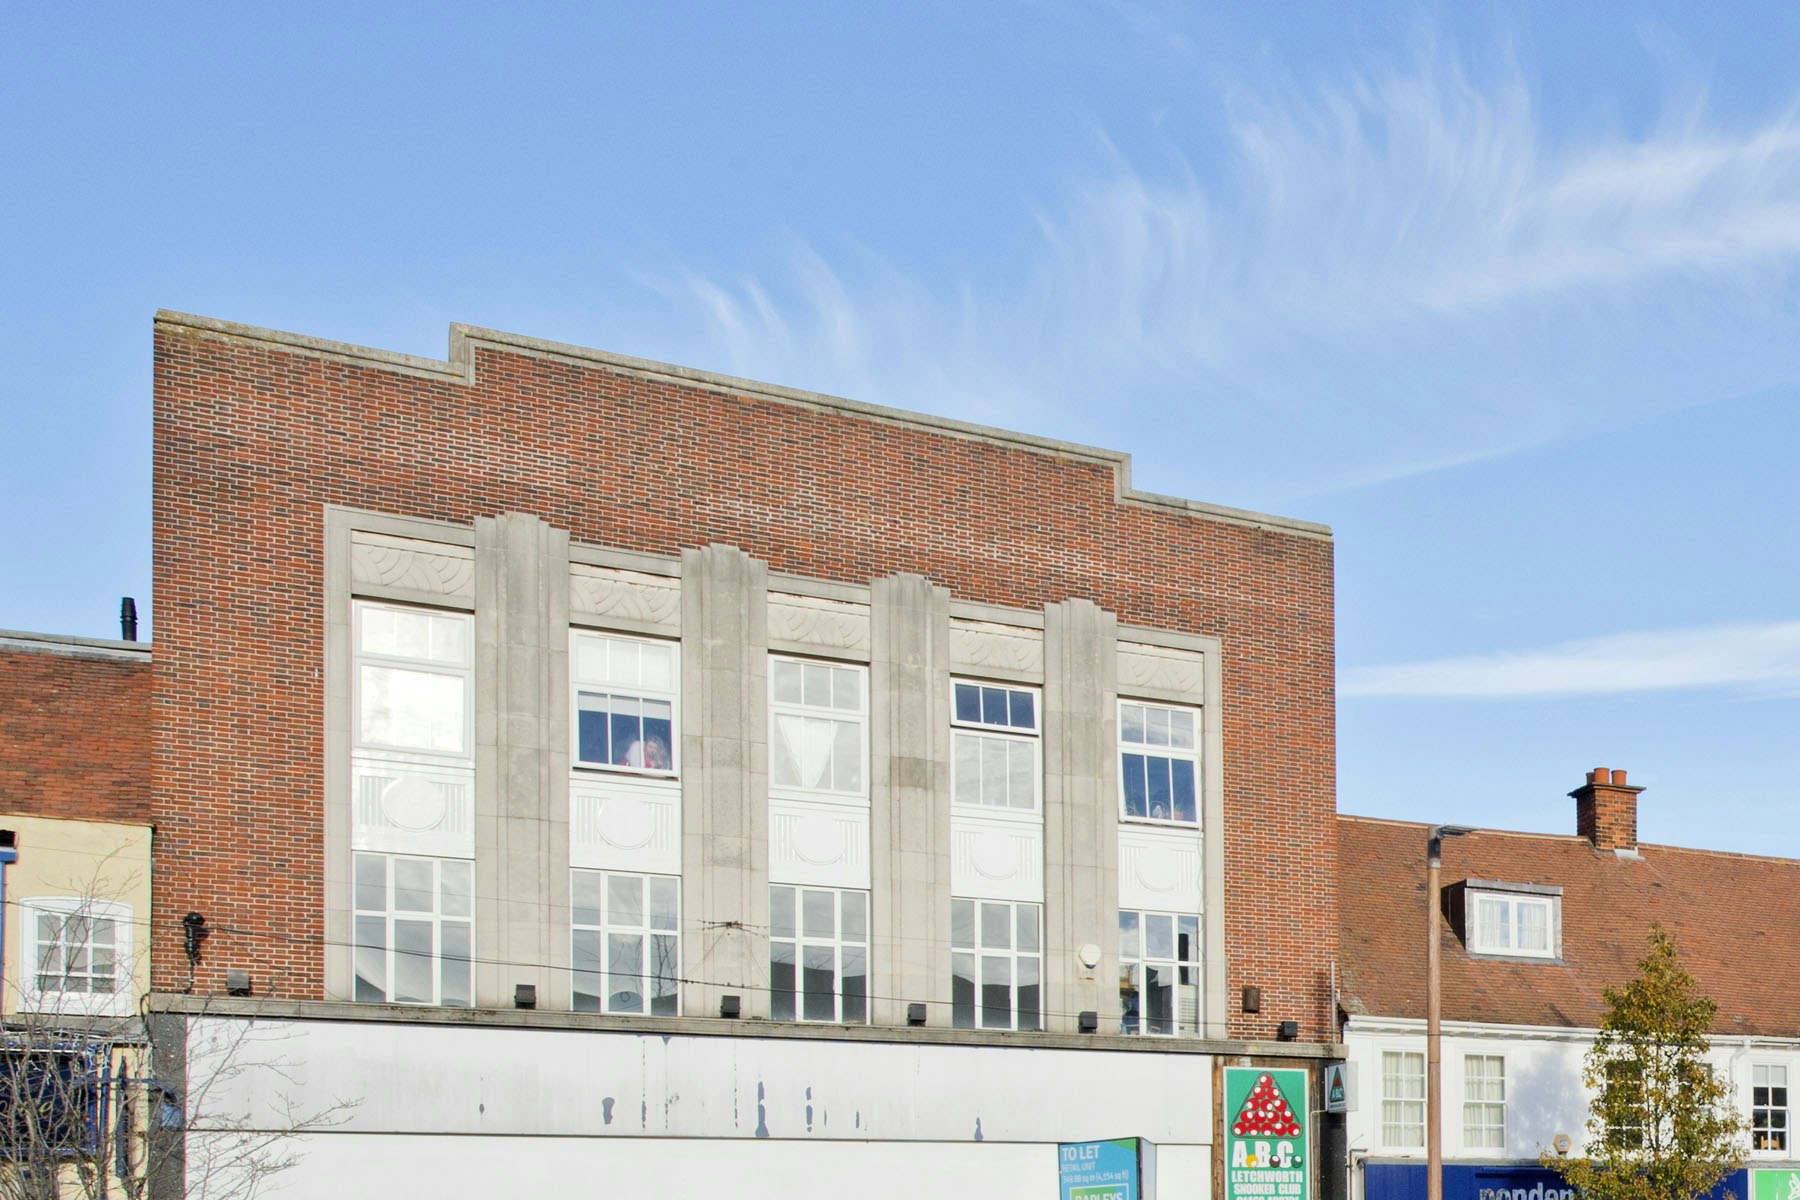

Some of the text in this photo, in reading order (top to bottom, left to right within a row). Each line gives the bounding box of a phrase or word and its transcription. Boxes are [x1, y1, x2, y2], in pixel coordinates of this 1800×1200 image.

[1062, 1145, 1100, 1161] TO LET
[1232, 1171, 1303, 1182] LETCHWORTH
[1234, 1184, 1302, 1195] SNOOKER CLUB
